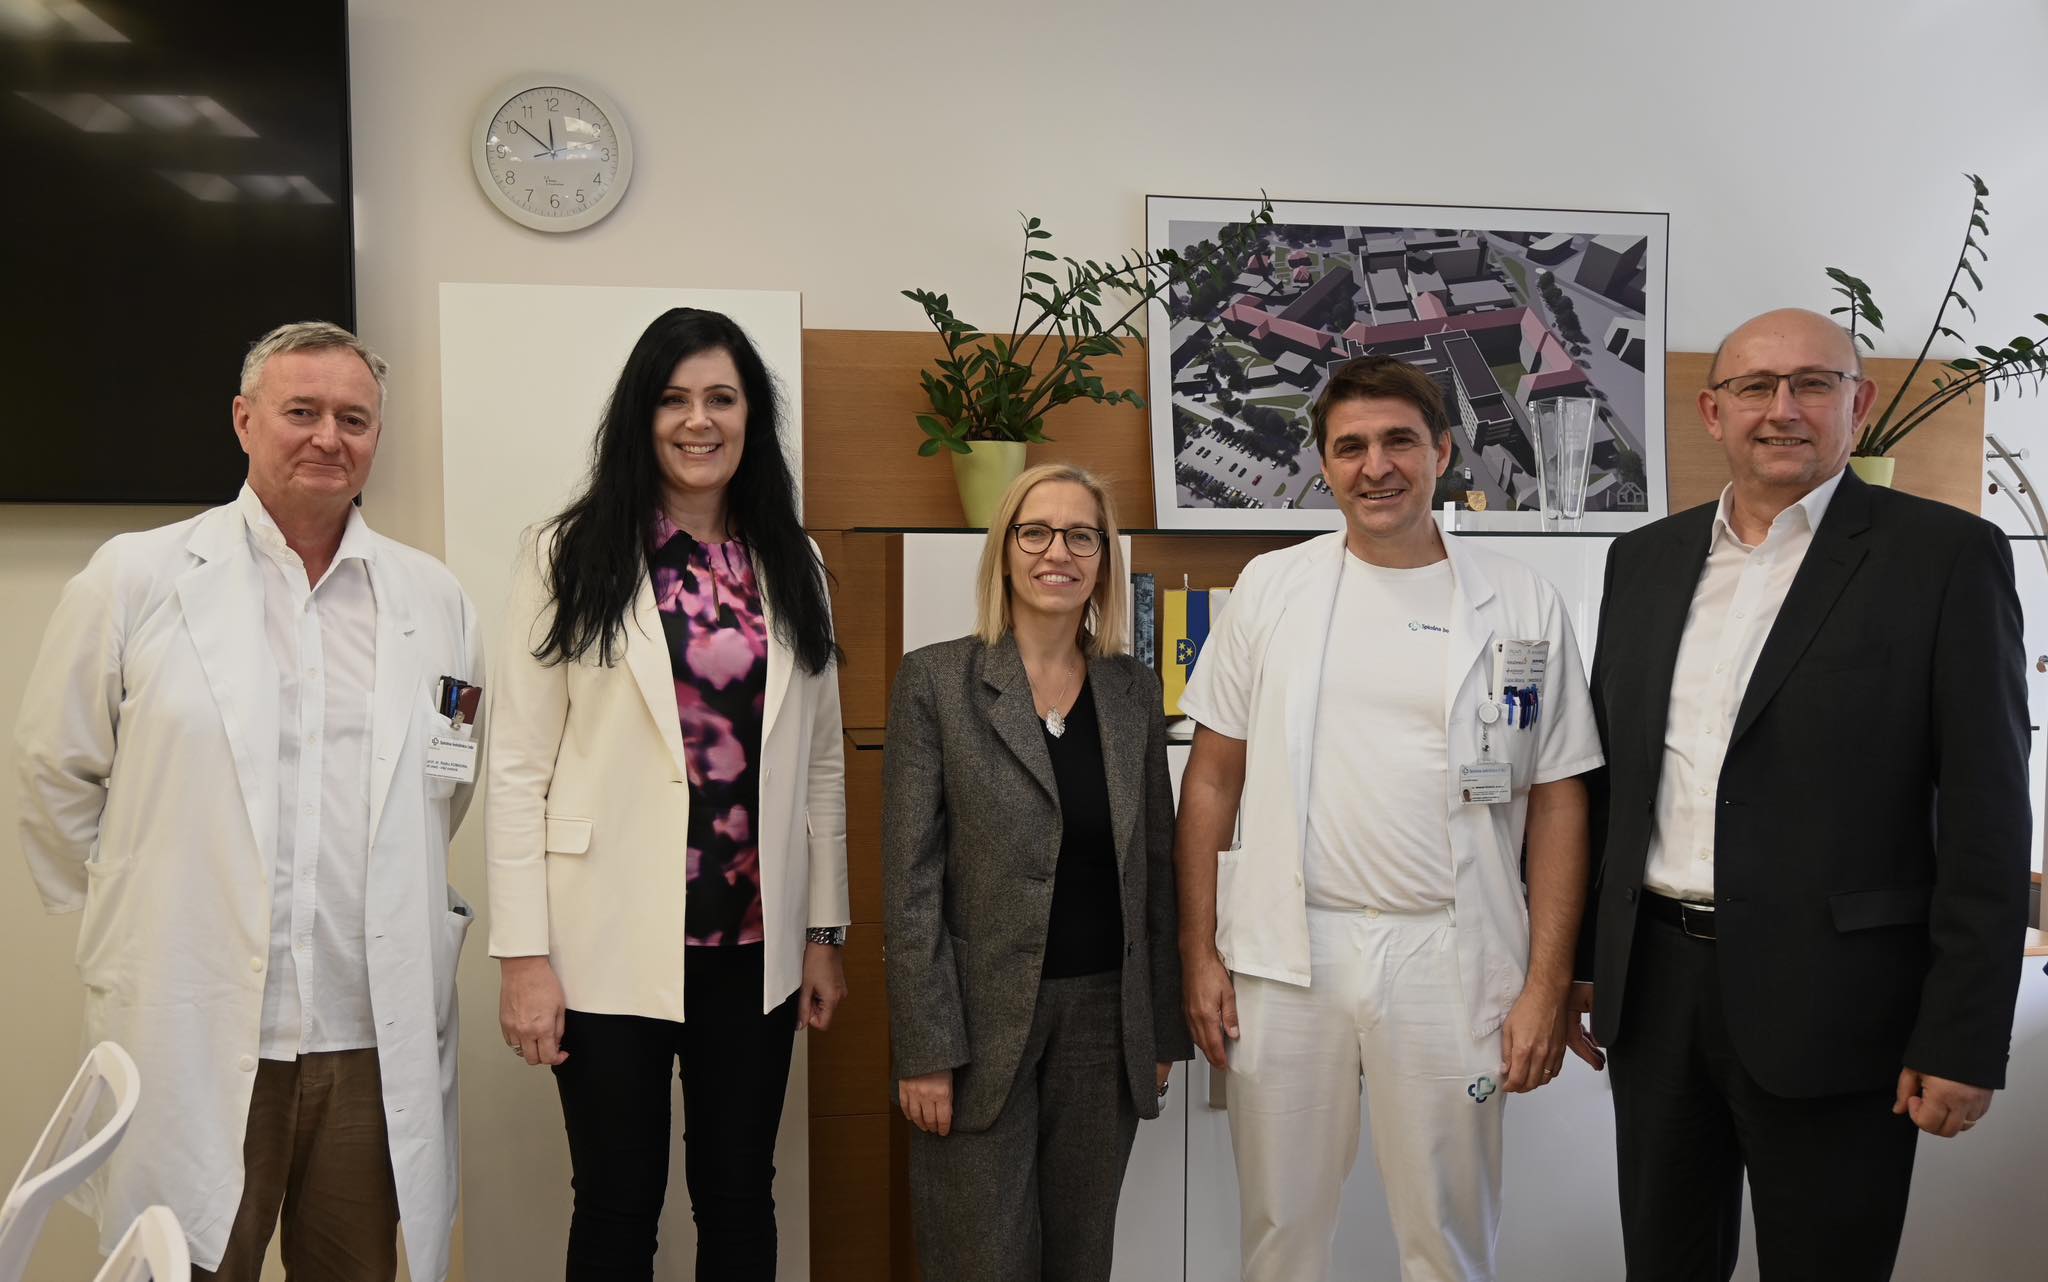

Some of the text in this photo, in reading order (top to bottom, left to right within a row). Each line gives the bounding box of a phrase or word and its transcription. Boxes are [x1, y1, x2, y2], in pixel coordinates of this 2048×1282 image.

[544, 98, 559, 112] 12
[522, 106, 533, 119] 11
[504, 120, 519, 135] 10
[591, 123, 600, 138] 2
[496, 144, 506, 158] 9
[601, 148, 610, 161] 3
[505, 170, 515, 185] 8
[592, 172, 601, 184] 4
[525, 189, 534, 202] 7
[550, 194, 560, 208] 6
[576, 189, 585, 203] 5
